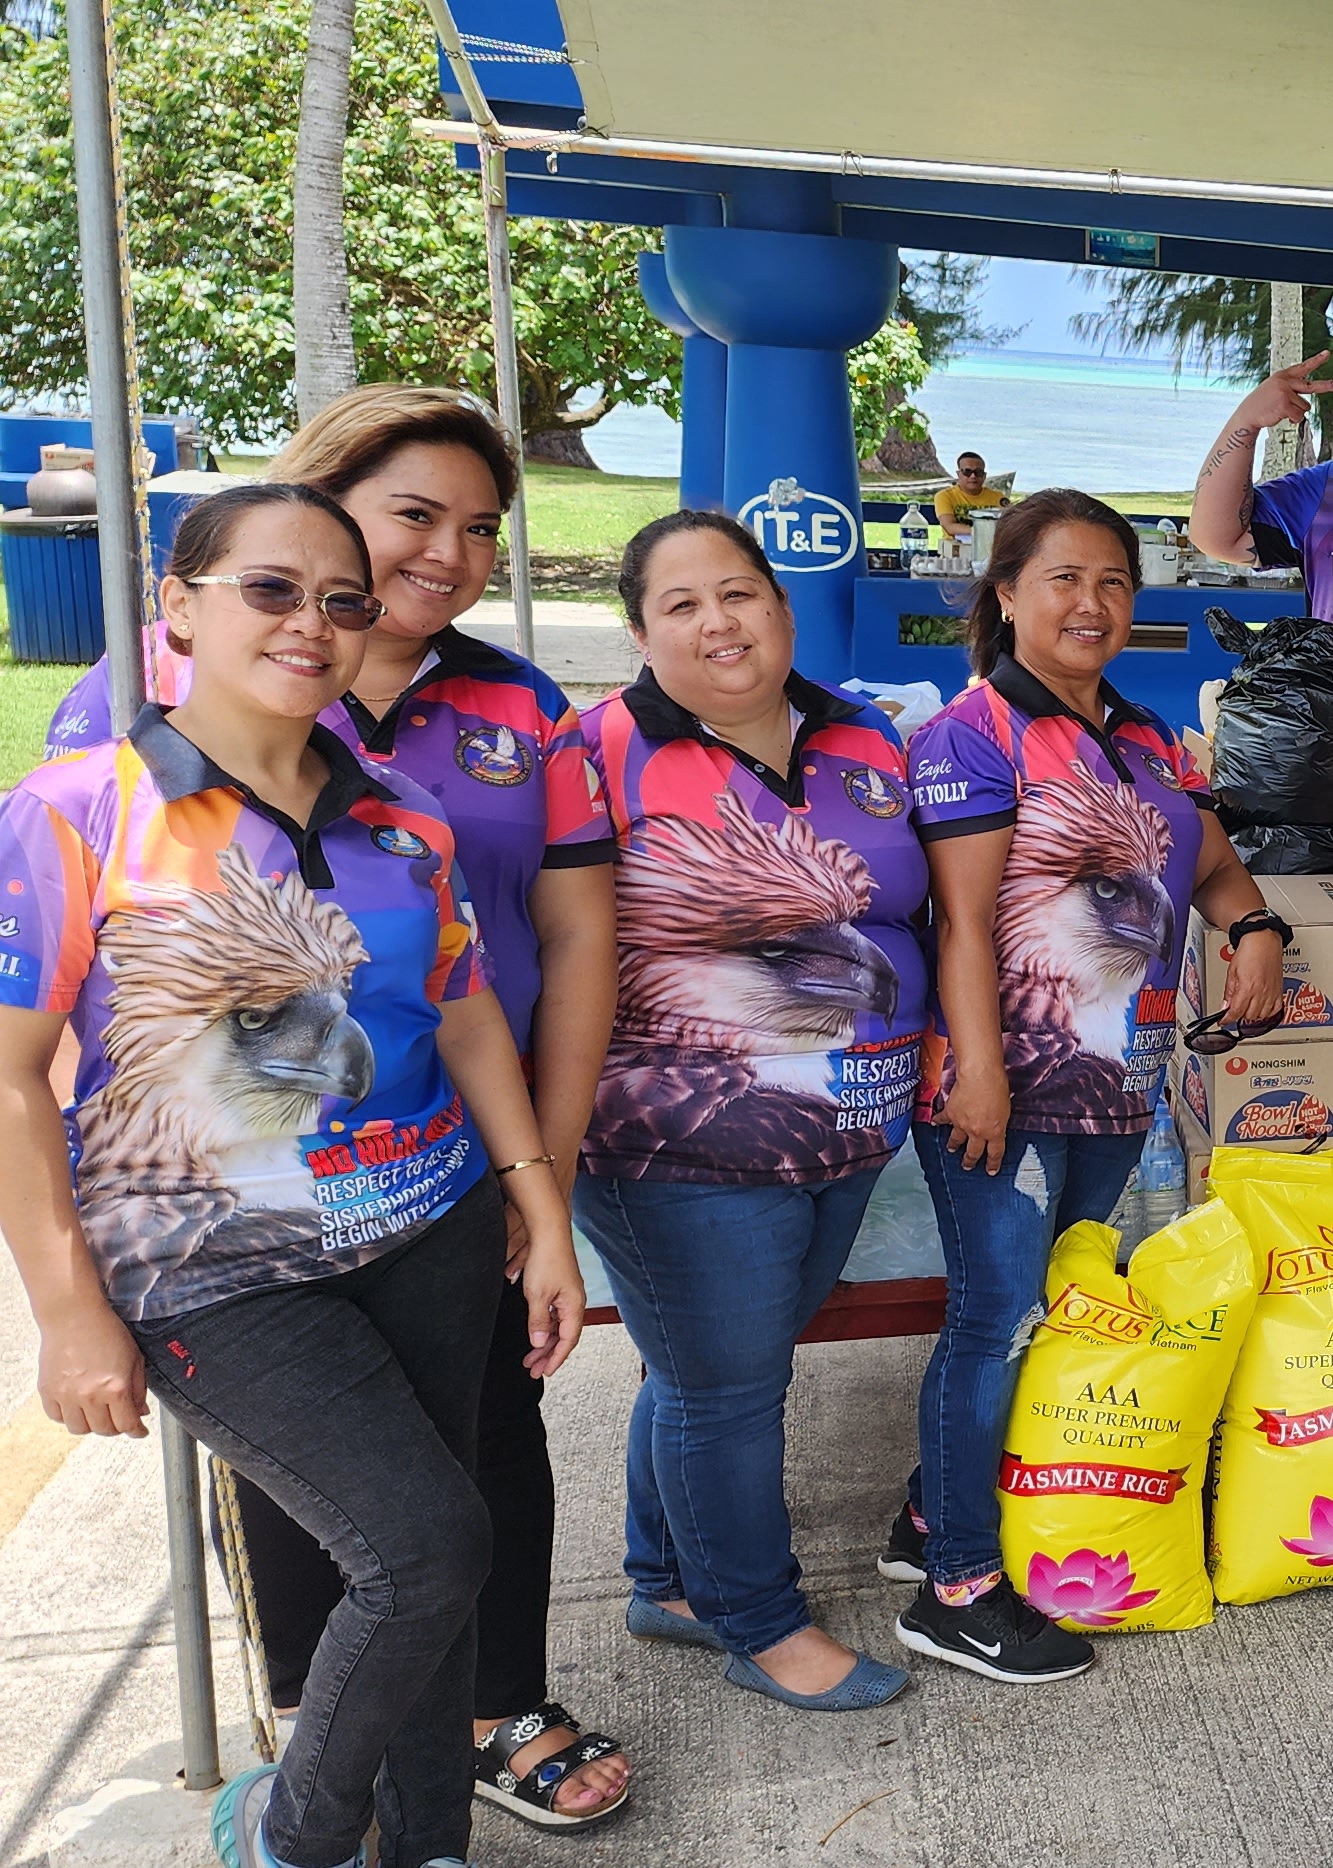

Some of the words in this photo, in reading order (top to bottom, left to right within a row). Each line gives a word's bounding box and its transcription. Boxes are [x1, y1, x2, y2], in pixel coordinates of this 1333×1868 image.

[753, 510, 842, 555] IT&E
[915, 757, 952, 781] Eagle
[926, 781, 968, 805] YOLLY
[1304, 1013, 1330, 1026] Soup
[842, 1052, 911, 1084] RESPECT
[1251, 1059, 1306, 1069] NONGSHIM
[836, 1107, 883, 1132] BEGIN
[885, 1098, 907, 1123] WITH
[1244, 1101, 1296, 1123] Bowl
[306, 1144, 356, 1178] NO
[316, 1167, 402, 1206] RESPECT
[405, 1157, 424, 1178] TO
[1075, 1382, 1141, 1409] AAA
[1031, 1401, 1095, 1424] SUPER
[1095, 1410, 1182, 1433] PREMIUM
[1063, 1428, 1148, 1449] QUALITY
[1008, 1469, 1118, 1491] JASMINE
[1121, 1474, 1170, 1497] RICE
[1285, 1573, 1314, 1587] NET
